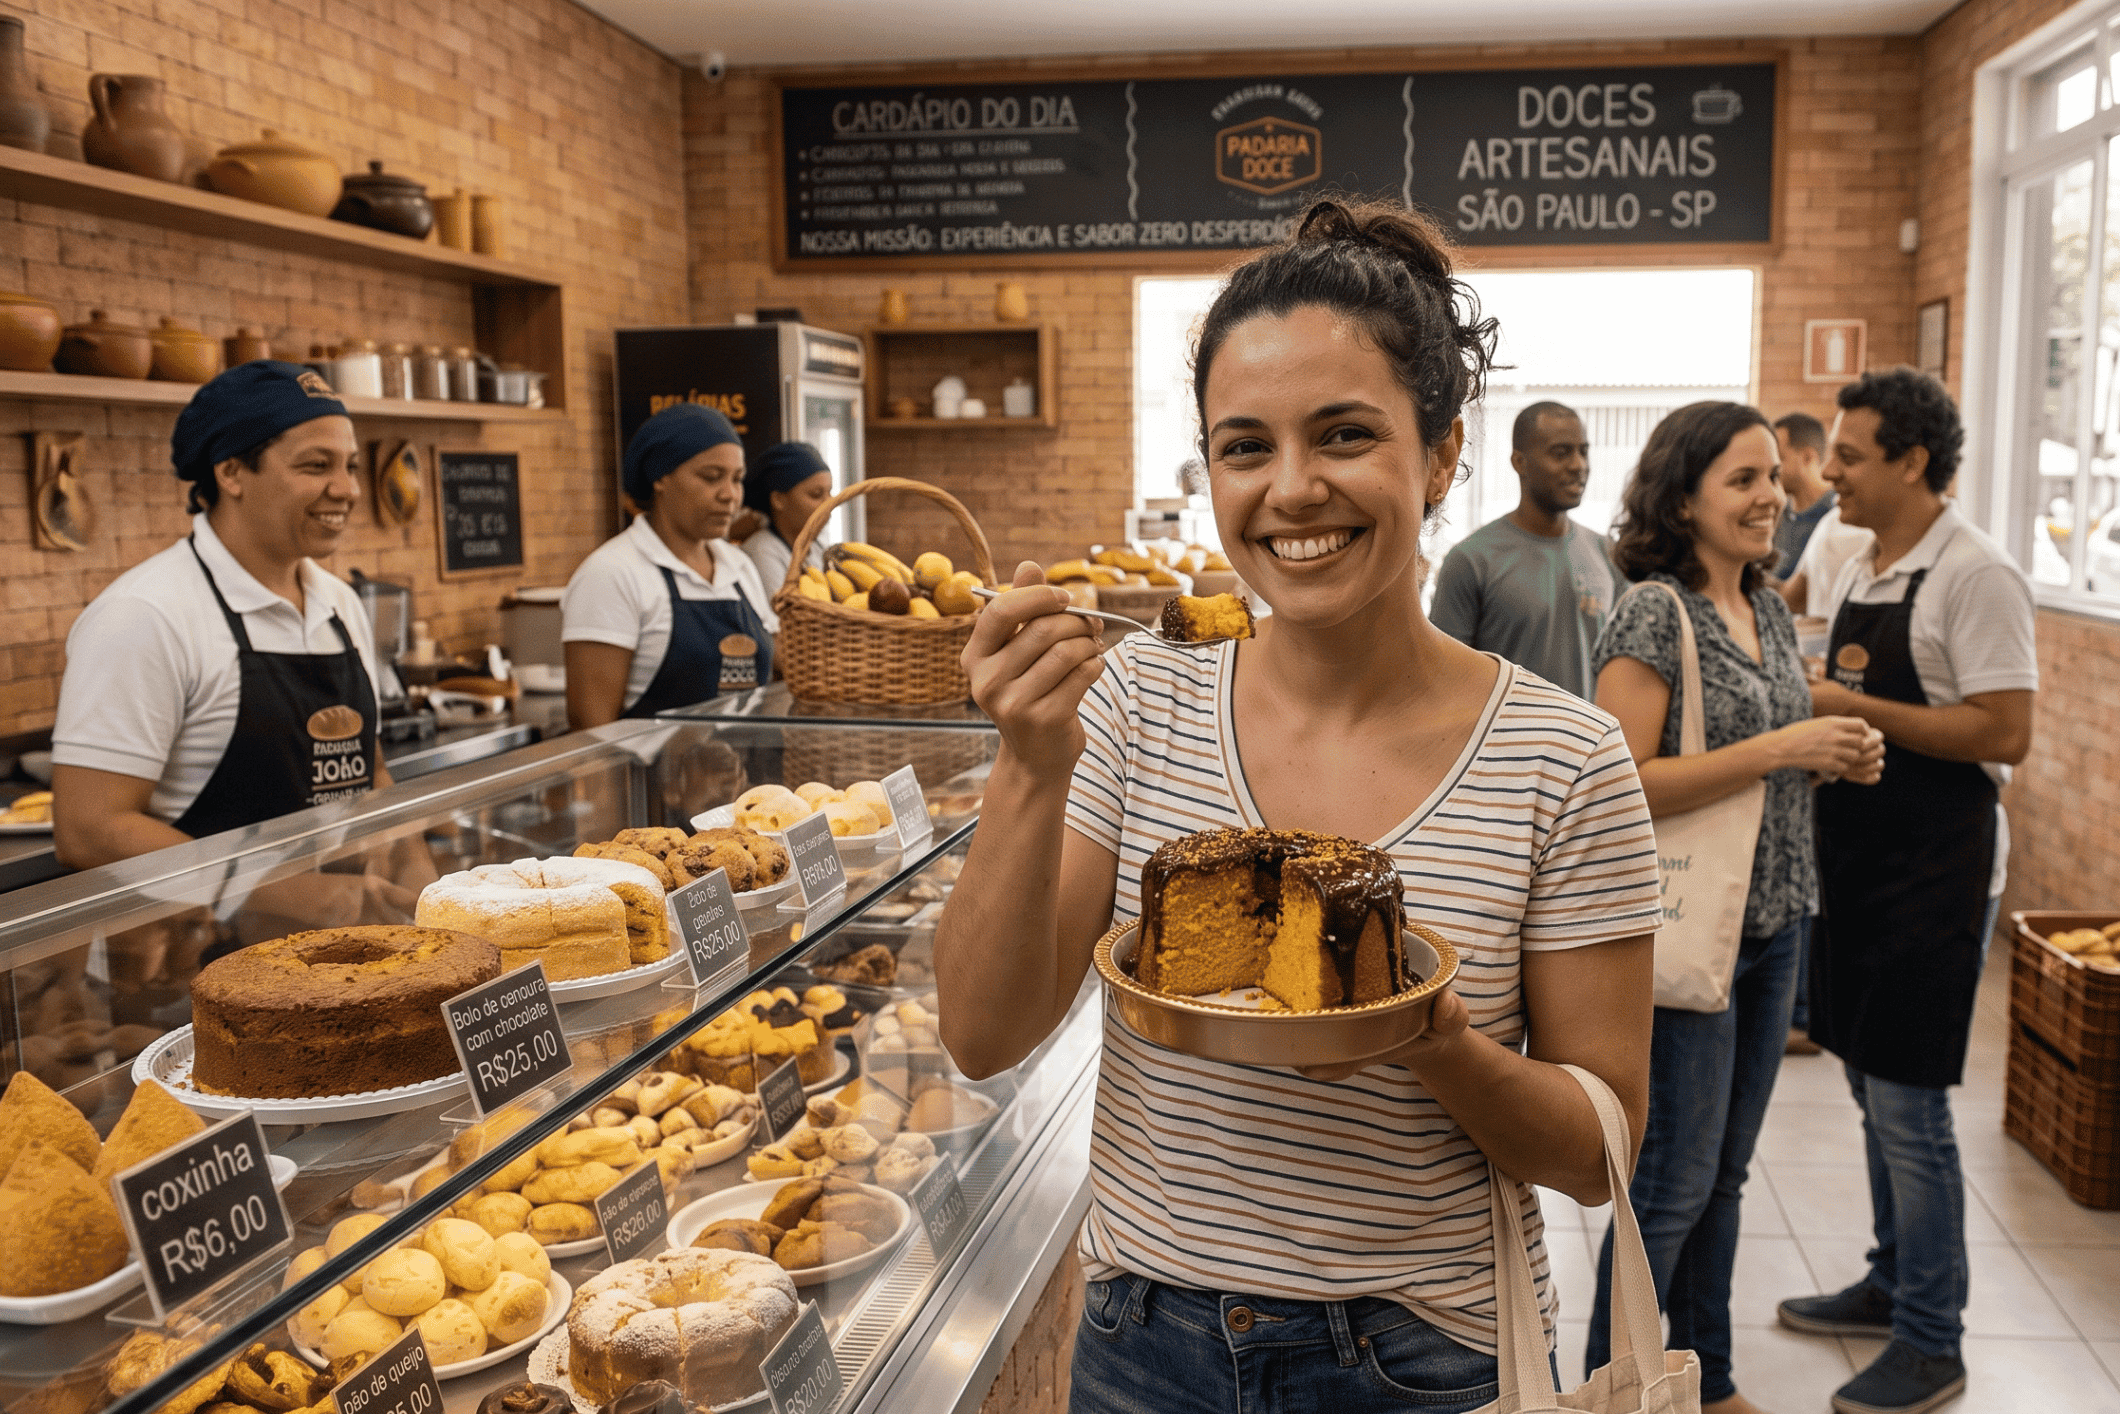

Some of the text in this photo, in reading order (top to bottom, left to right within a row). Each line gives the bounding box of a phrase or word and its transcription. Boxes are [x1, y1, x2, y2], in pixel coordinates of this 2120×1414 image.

[832, 91, 1079, 133] CARDÁPIO DO DIA
[1517, 82, 1657, 129] DOCES
[1226, 134, 1311, 158] PADARIA
[1242, 156, 1296, 181] DOCE
[1457, 133, 1718, 181] ARTESANAIS
[1457, 187, 1526, 232] SÃO
[1536, 192, 1642, 231] PAULO
[1670, 190, 1718, 229] SP
[800, 229, 861, 253] NOSSA
[863, 223, 933, 251] MISSÃO
[941, 219, 1052, 250] EXPERIÊNCIA
[1057, 223, 1070, 247] E
[1073, 222, 1136, 248] SABOR
[1139, 219, 1188, 245] ZERO
[452, 977, 546, 1031] Bolo de cenoura
[466, 1002, 549, 1052] com chocolate
[476, 1029, 558, 1093] R$25,00
[141, 1142, 255, 1221] coxinha
[159, 1194, 267, 1284] R$6,00
[370, 1374, 388, 1397] de
[388, 1346, 424, 1386] queijo
